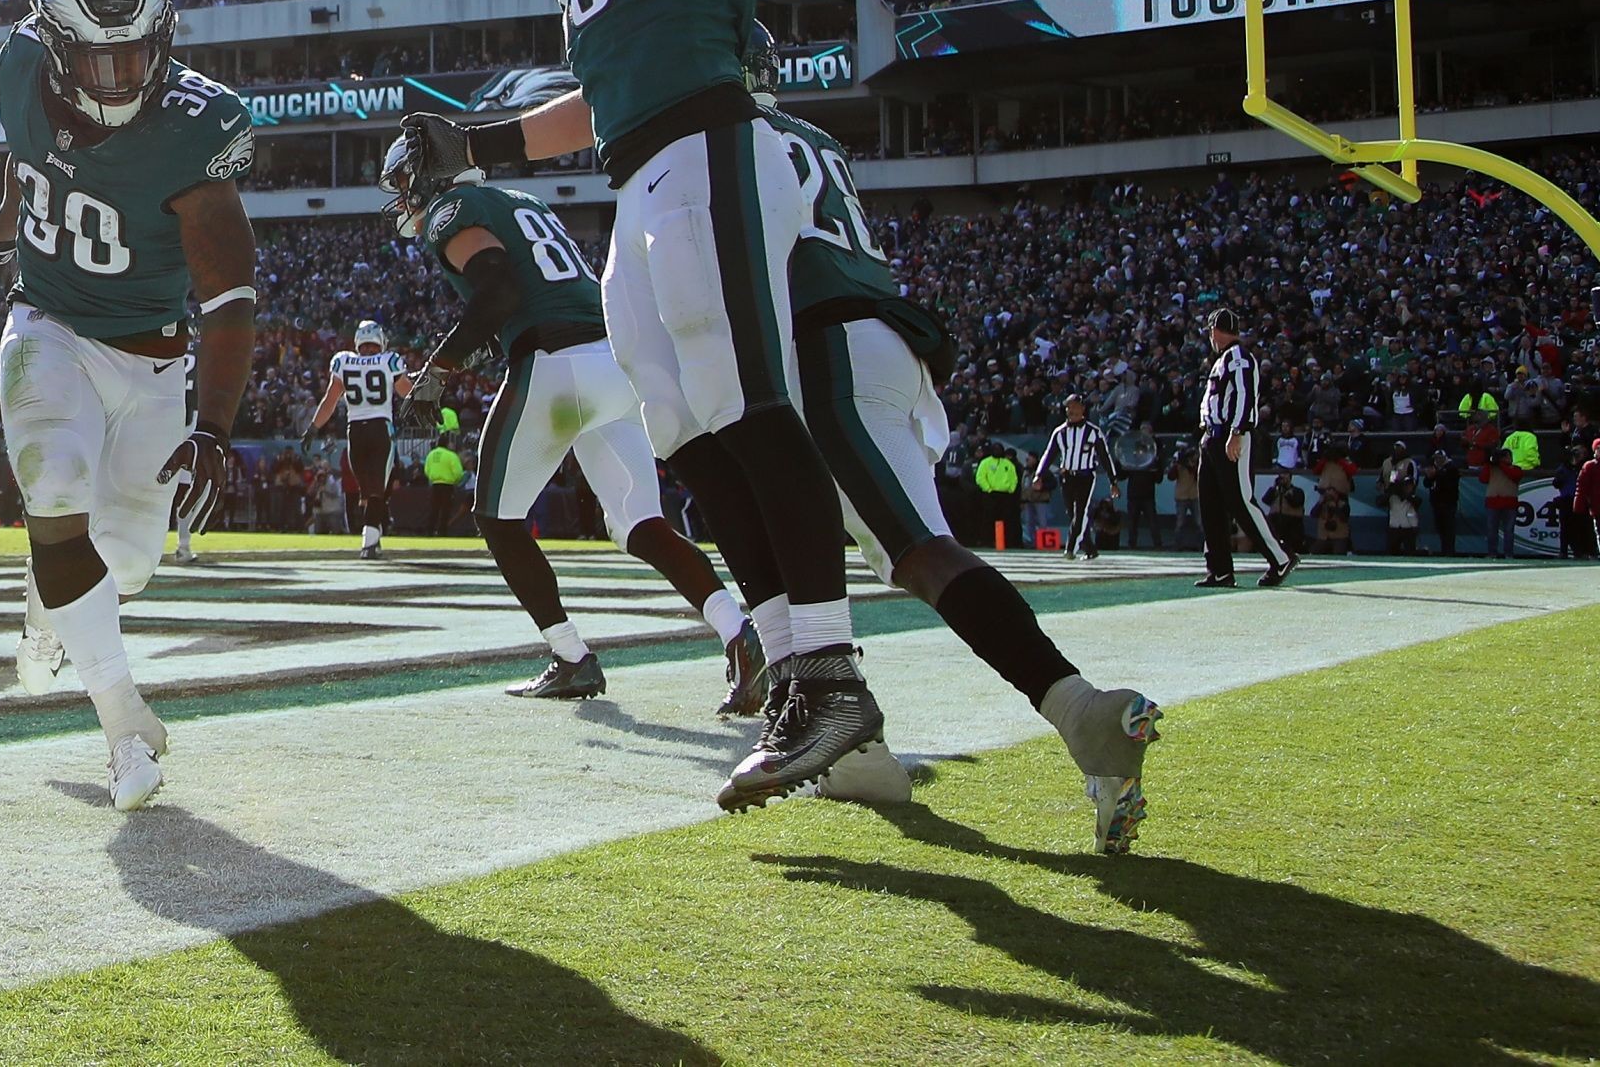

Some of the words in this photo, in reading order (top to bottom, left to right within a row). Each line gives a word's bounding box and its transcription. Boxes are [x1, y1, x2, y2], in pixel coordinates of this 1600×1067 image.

[45, 151, 77, 179] EAGLES
[1579, 338, 1596, 352] 92
[343, 369, 388, 406] 59
[1042, 532, 1057, 549] G
[1529, 528, 1560, 541] Spo
